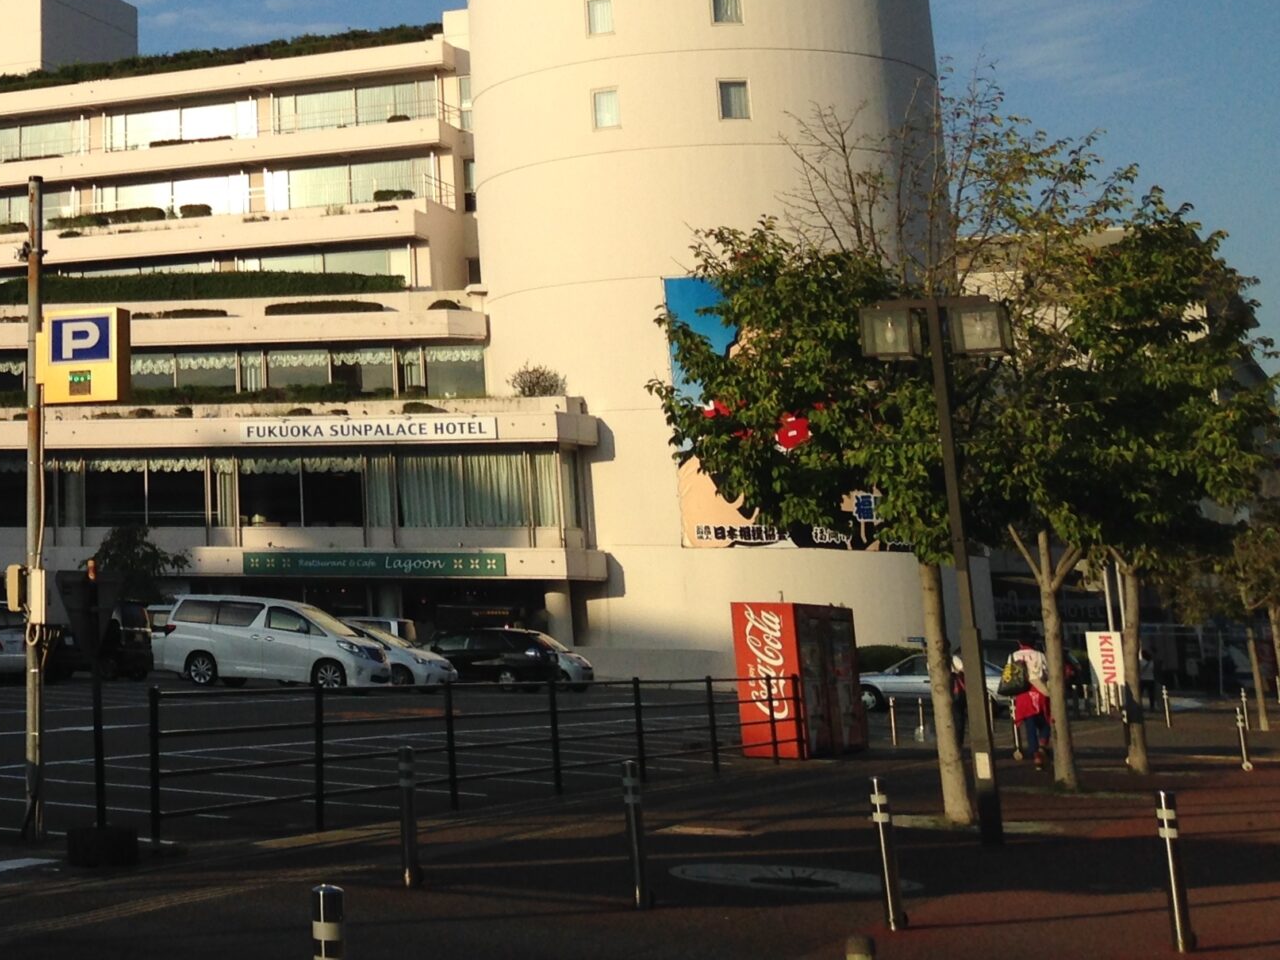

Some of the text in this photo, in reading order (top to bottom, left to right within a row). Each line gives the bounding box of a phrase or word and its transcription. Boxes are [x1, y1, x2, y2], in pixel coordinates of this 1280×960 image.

[62, 321, 100, 359] P
[247, 421, 487, 438] FUKUOKA SUNPALACE HOTEL
[385, 556, 446, 574] Lagoon
[1098, 635, 1117, 684] KIRIN
